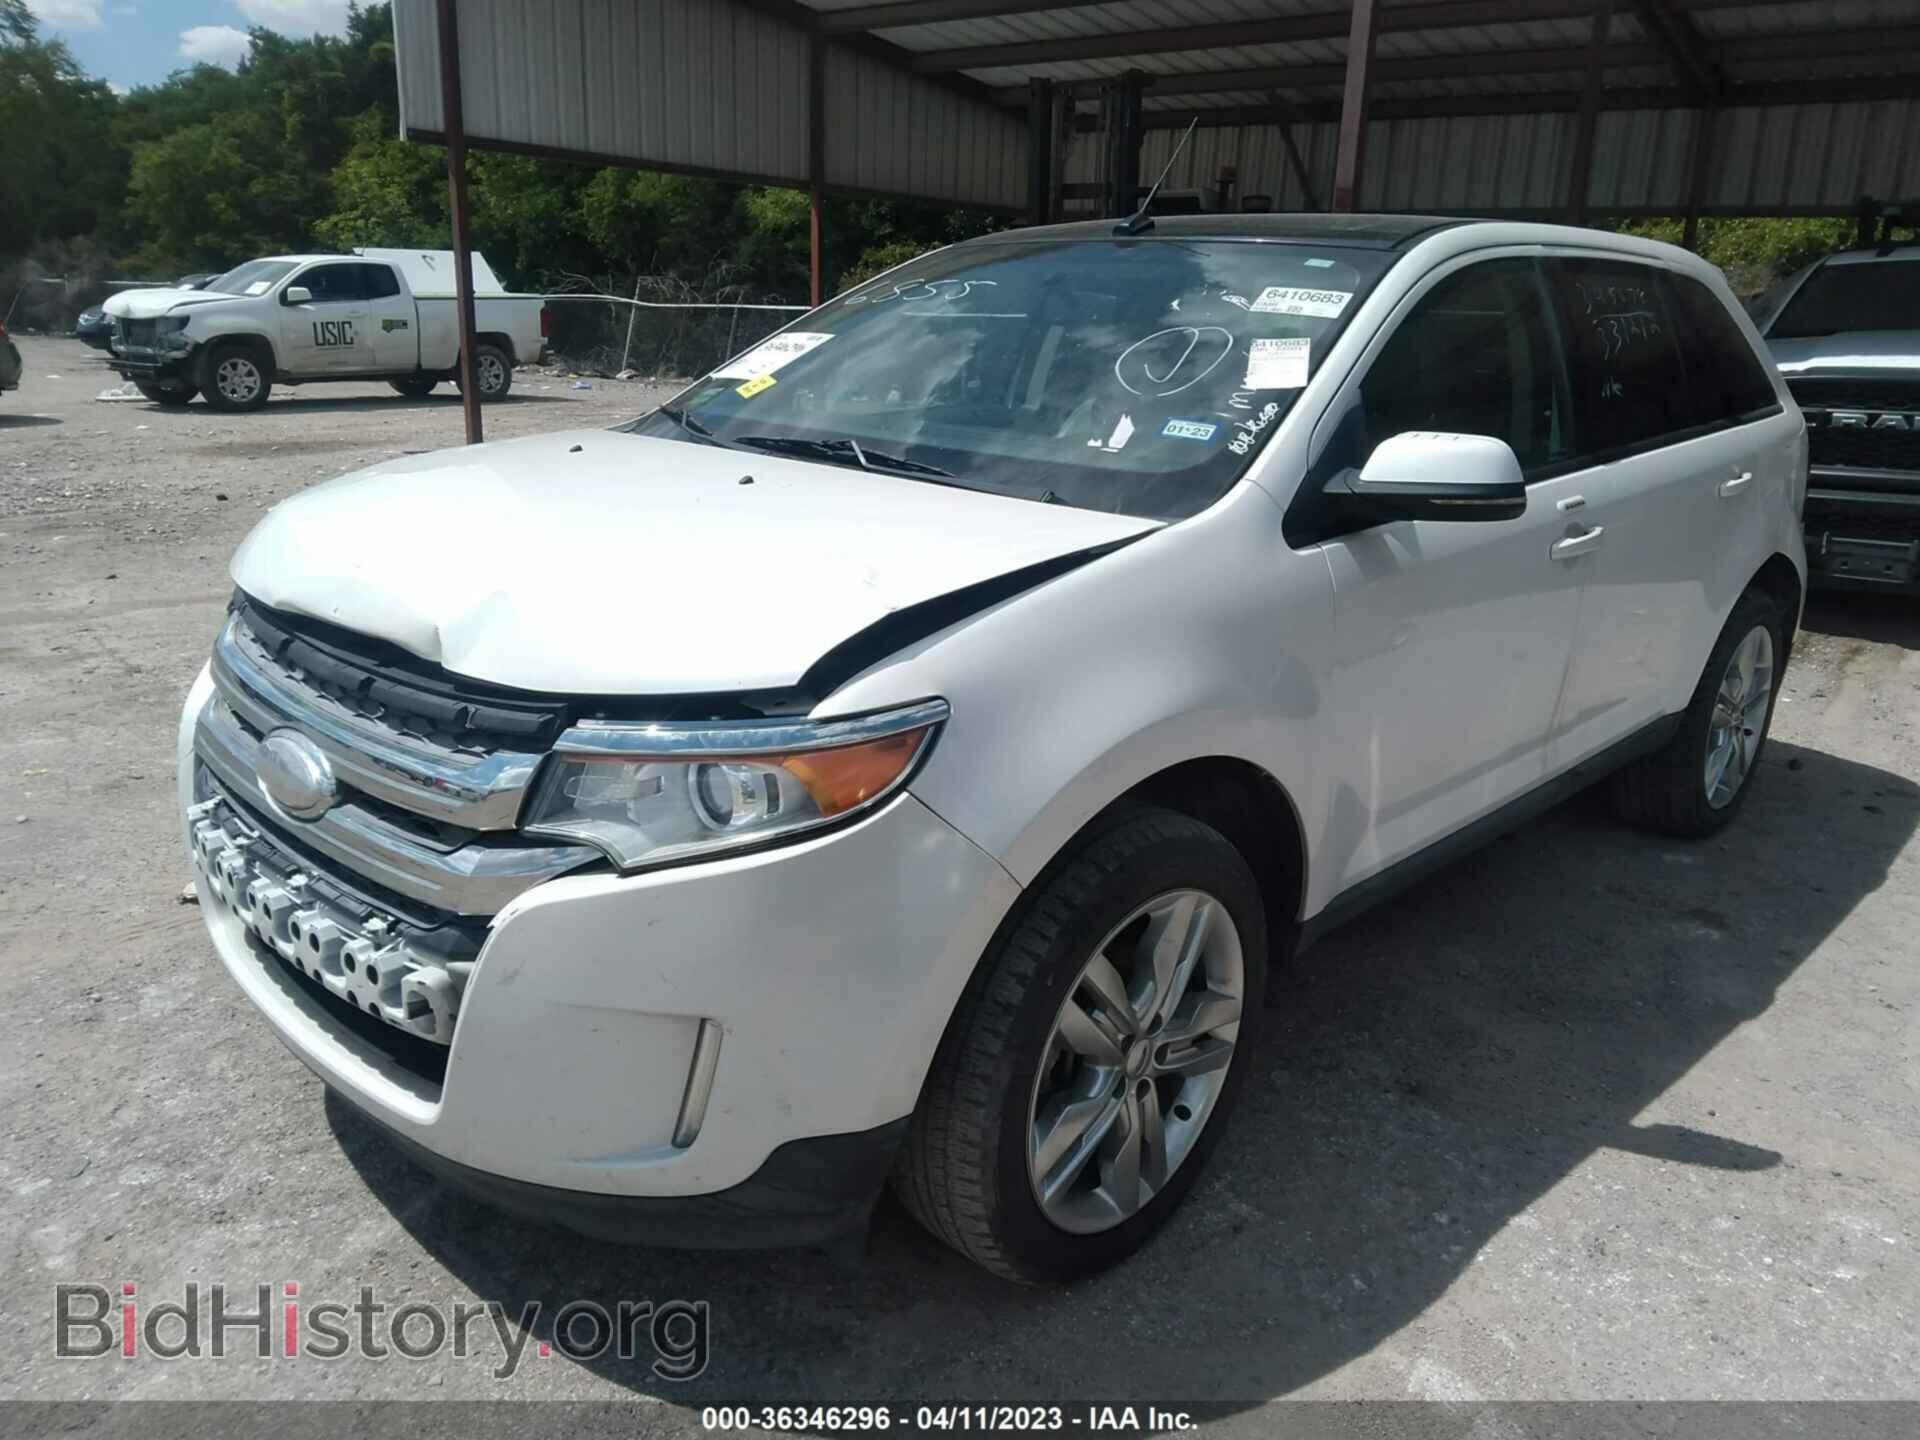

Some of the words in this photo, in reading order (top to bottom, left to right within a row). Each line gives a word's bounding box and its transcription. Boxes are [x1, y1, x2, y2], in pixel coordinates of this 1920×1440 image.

[1265, 288, 1345, 305] 6410683
[312, 320, 354, 346] USIC
[1832, 412, 1920, 430] RA
